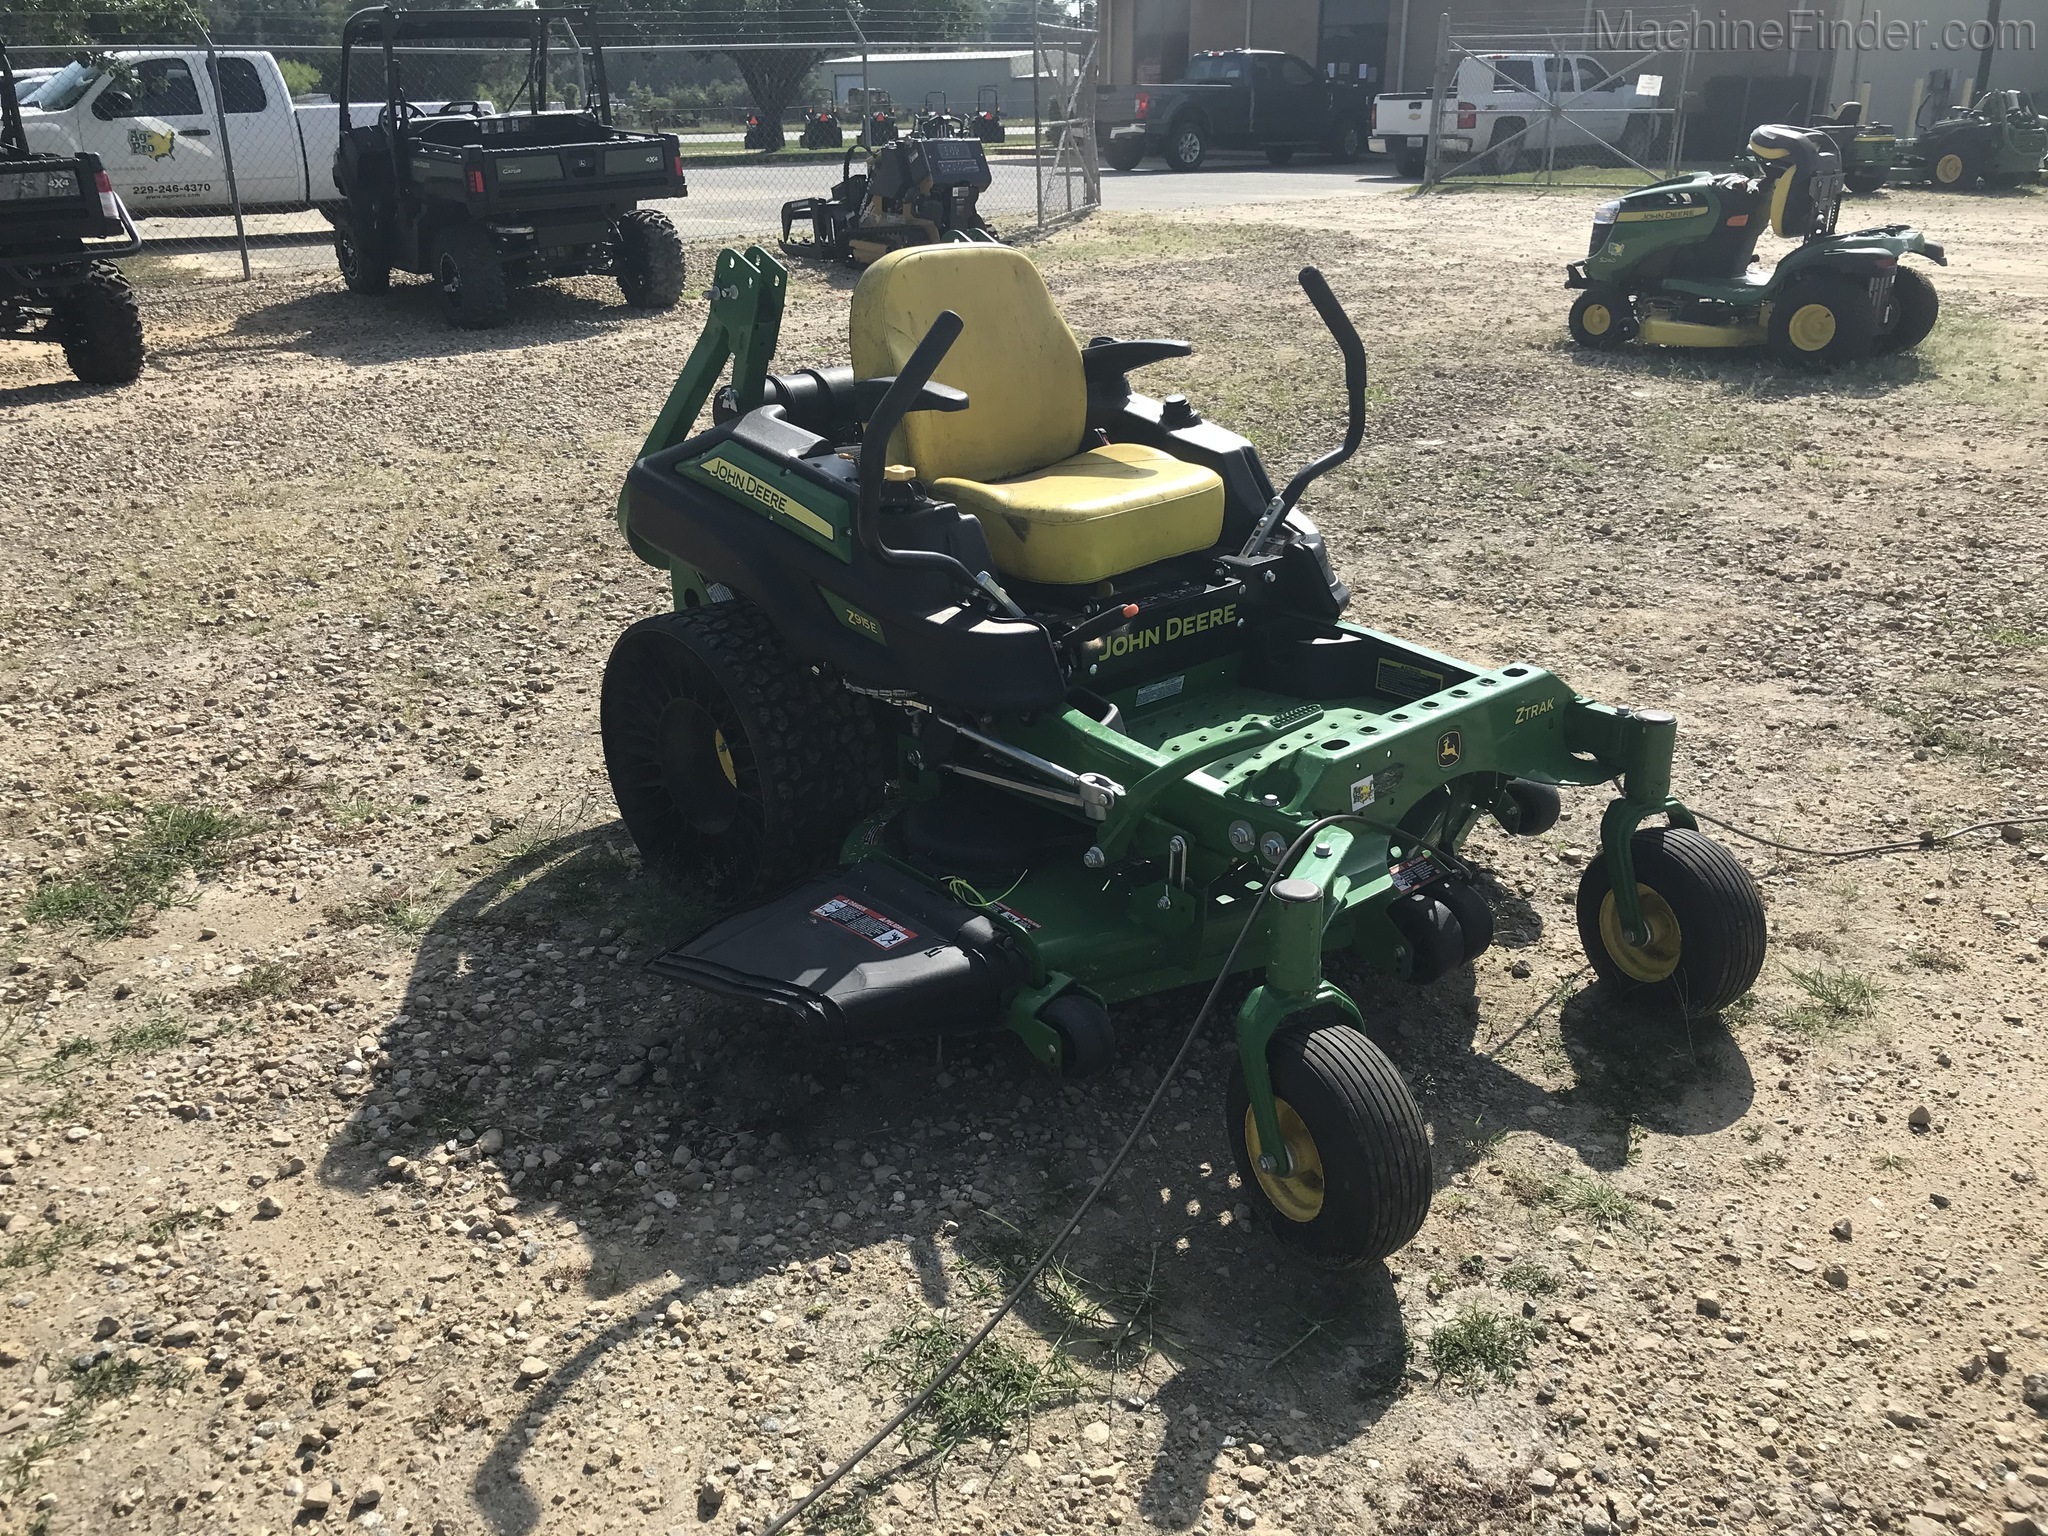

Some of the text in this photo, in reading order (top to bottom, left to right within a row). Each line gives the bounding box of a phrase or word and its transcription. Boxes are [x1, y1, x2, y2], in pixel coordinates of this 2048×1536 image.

[130, 130, 152, 144] Ag-
[131, 142, 155, 154] Pro
[133, 183, 211, 195] 229-246-4370
[1642, 210, 1695, 220] JOHN DEERE
[711, 461, 788, 513] JOHN DEERE
[846, 608, 878, 634] Z915E
[1099, 603, 1237, 662] JOHN DEERE
